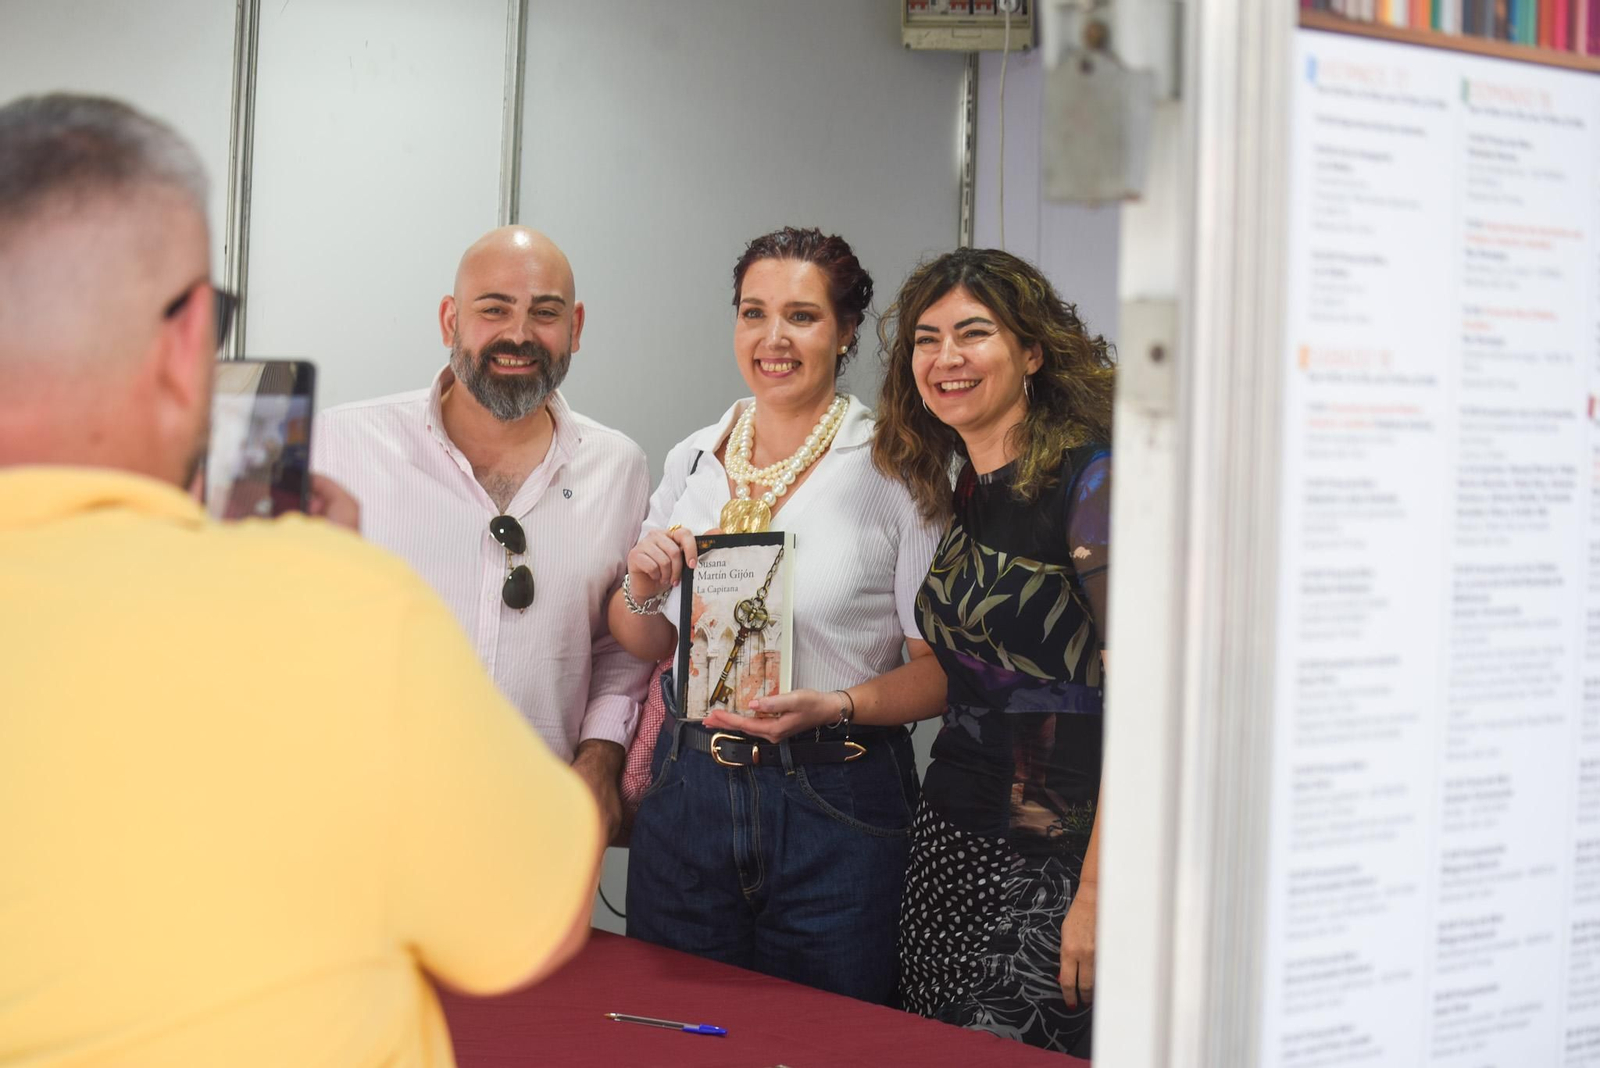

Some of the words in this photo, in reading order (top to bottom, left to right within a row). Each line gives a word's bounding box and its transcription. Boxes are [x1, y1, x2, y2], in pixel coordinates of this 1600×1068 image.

[698, 559, 726, 568] Susana
[698, 570, 727, 580] Martín
[729, 569, 754, 581] Gijón
[697, 586, 705, 594] La
[707, 585, 739, 595] Capitana
